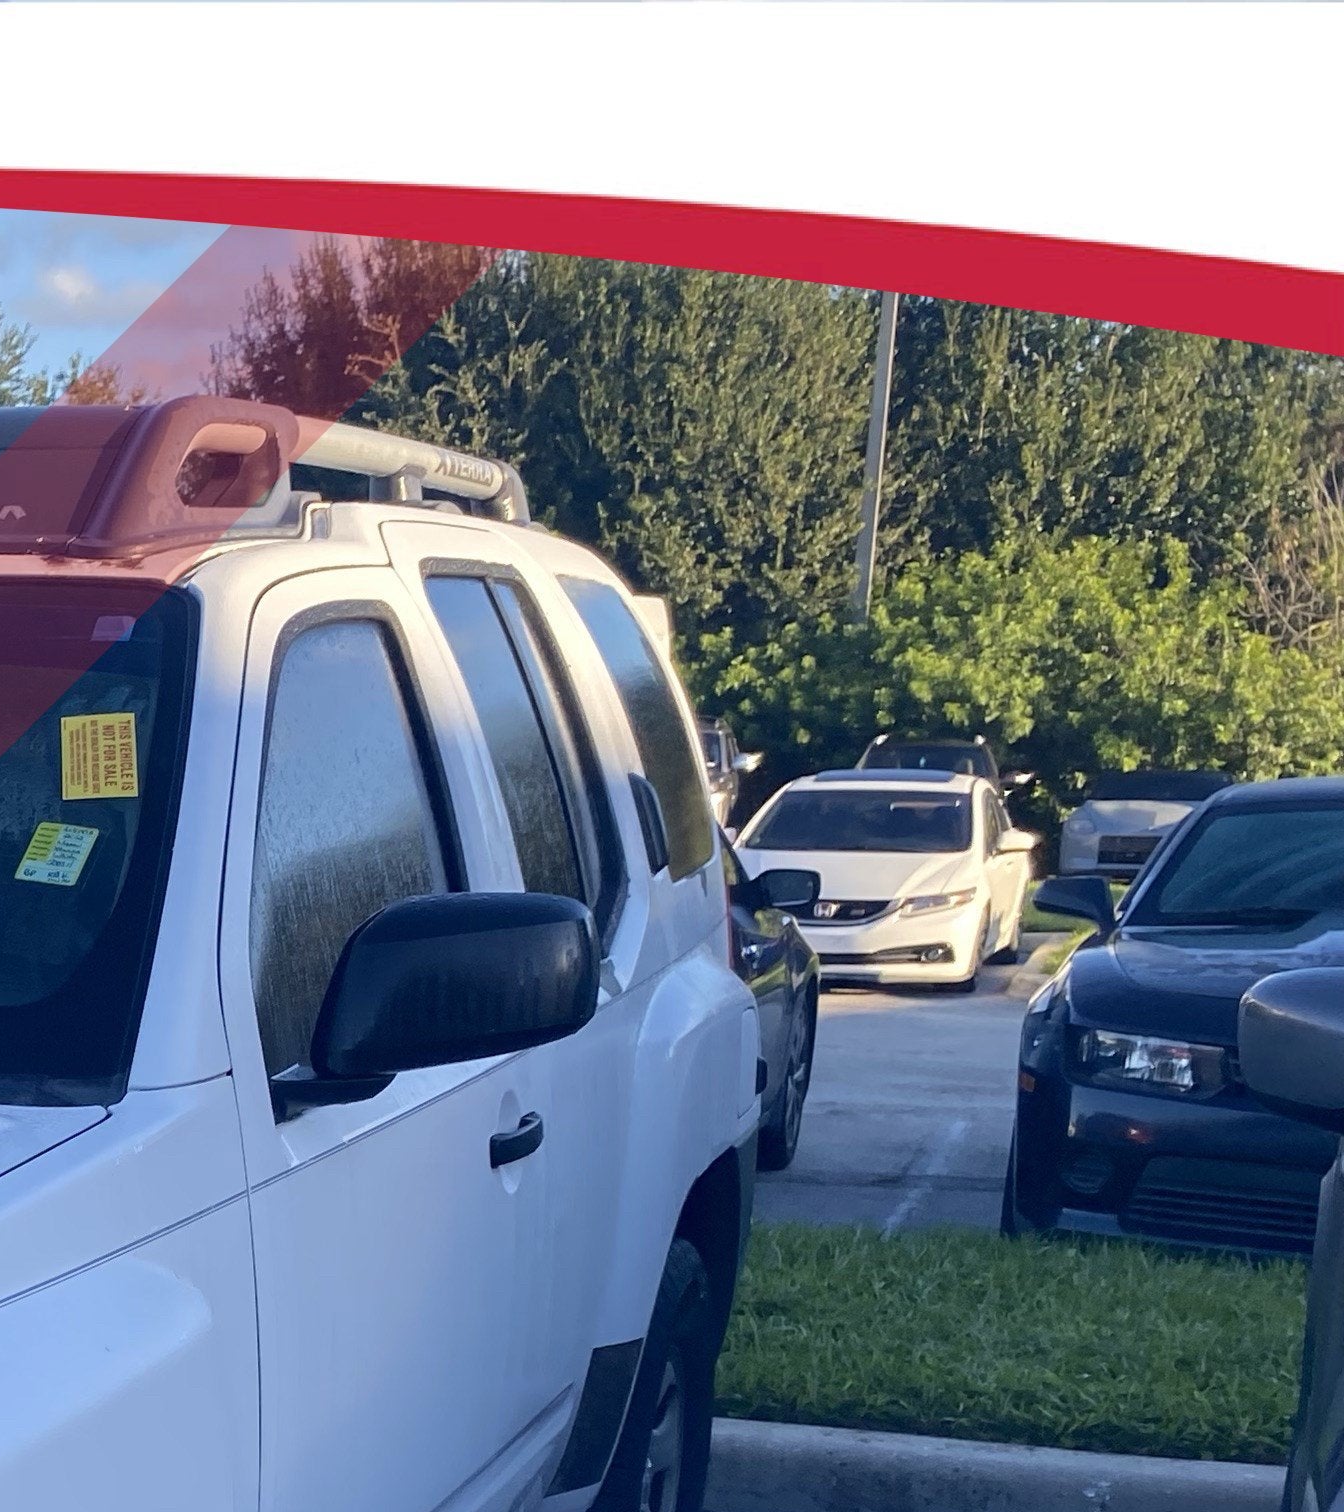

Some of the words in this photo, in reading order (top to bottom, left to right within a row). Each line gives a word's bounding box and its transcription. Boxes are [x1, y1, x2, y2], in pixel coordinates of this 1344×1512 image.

[102, 724, 116, 742] NOT
[118, 719, 132, 740] THIS
[103, 744, 117, 761] FOR
[119, 742, 134, 779] VEHICLE
[103, 764, 118, 787] SALE
[120, 781, 135, 791] IS
